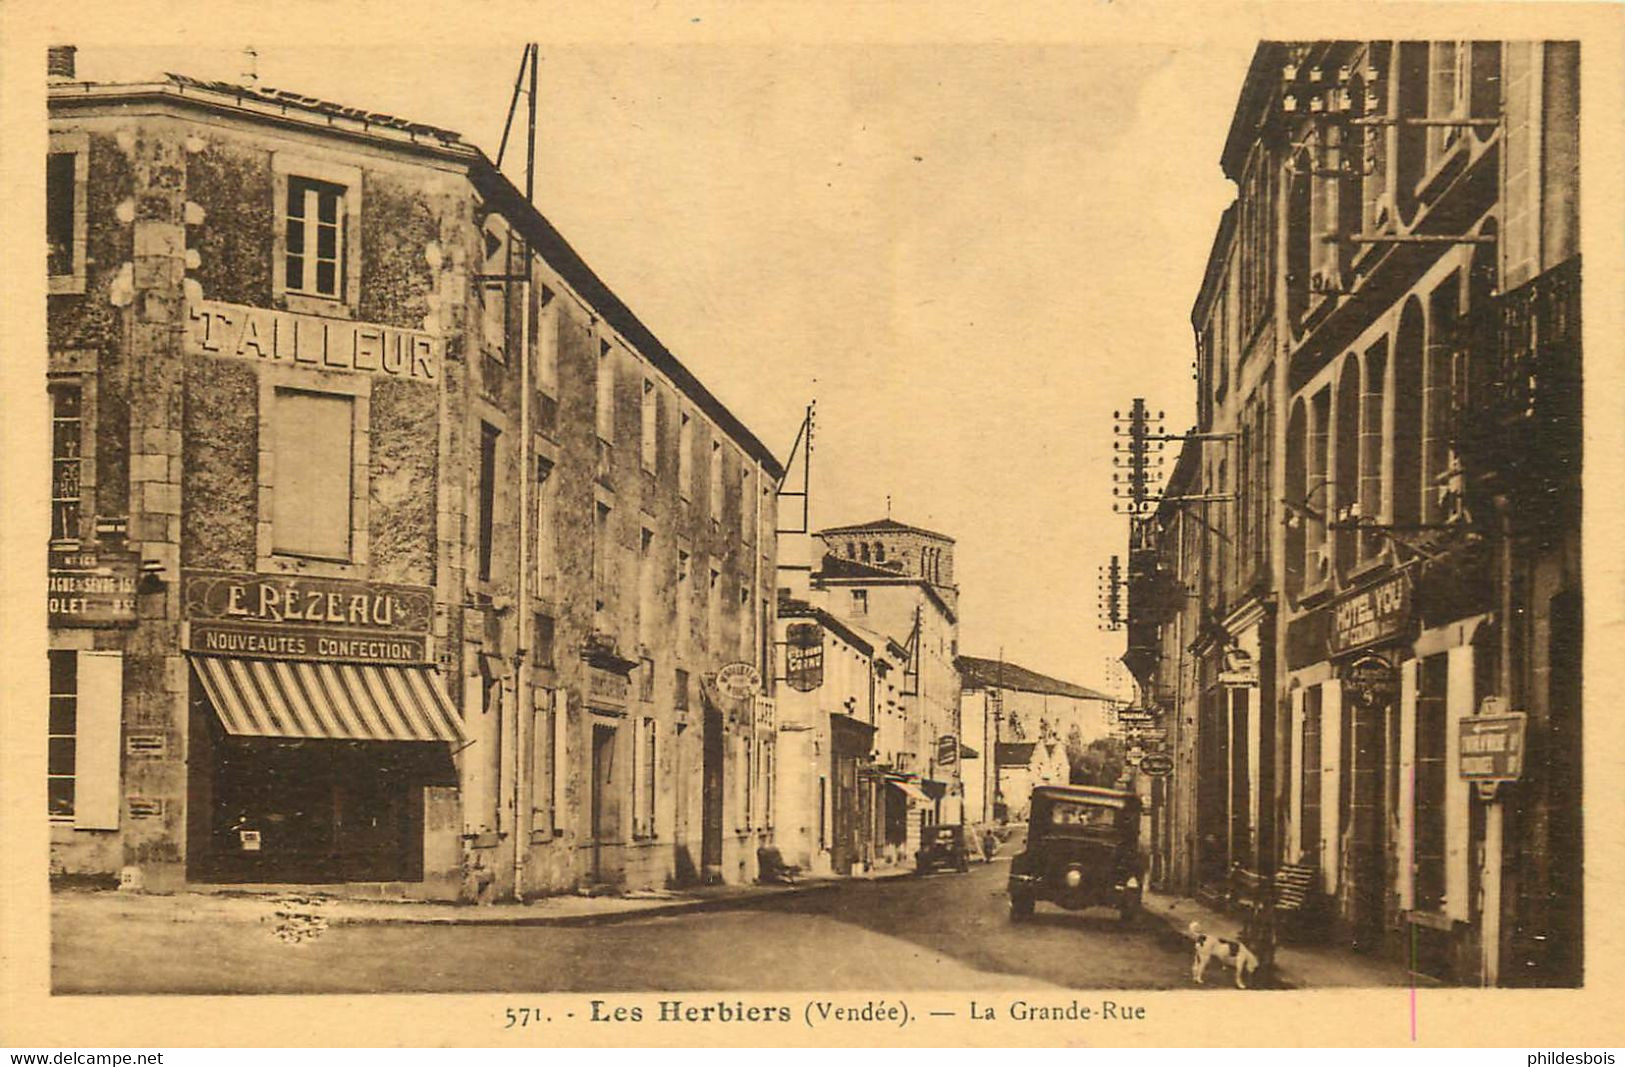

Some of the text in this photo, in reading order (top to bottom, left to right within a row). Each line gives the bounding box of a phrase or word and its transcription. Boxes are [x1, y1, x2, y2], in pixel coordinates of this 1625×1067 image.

[189, 306, 434, 379] TAILLEUR
[205, 631, 413, 660] NOUVEAUTES CONFECTION
